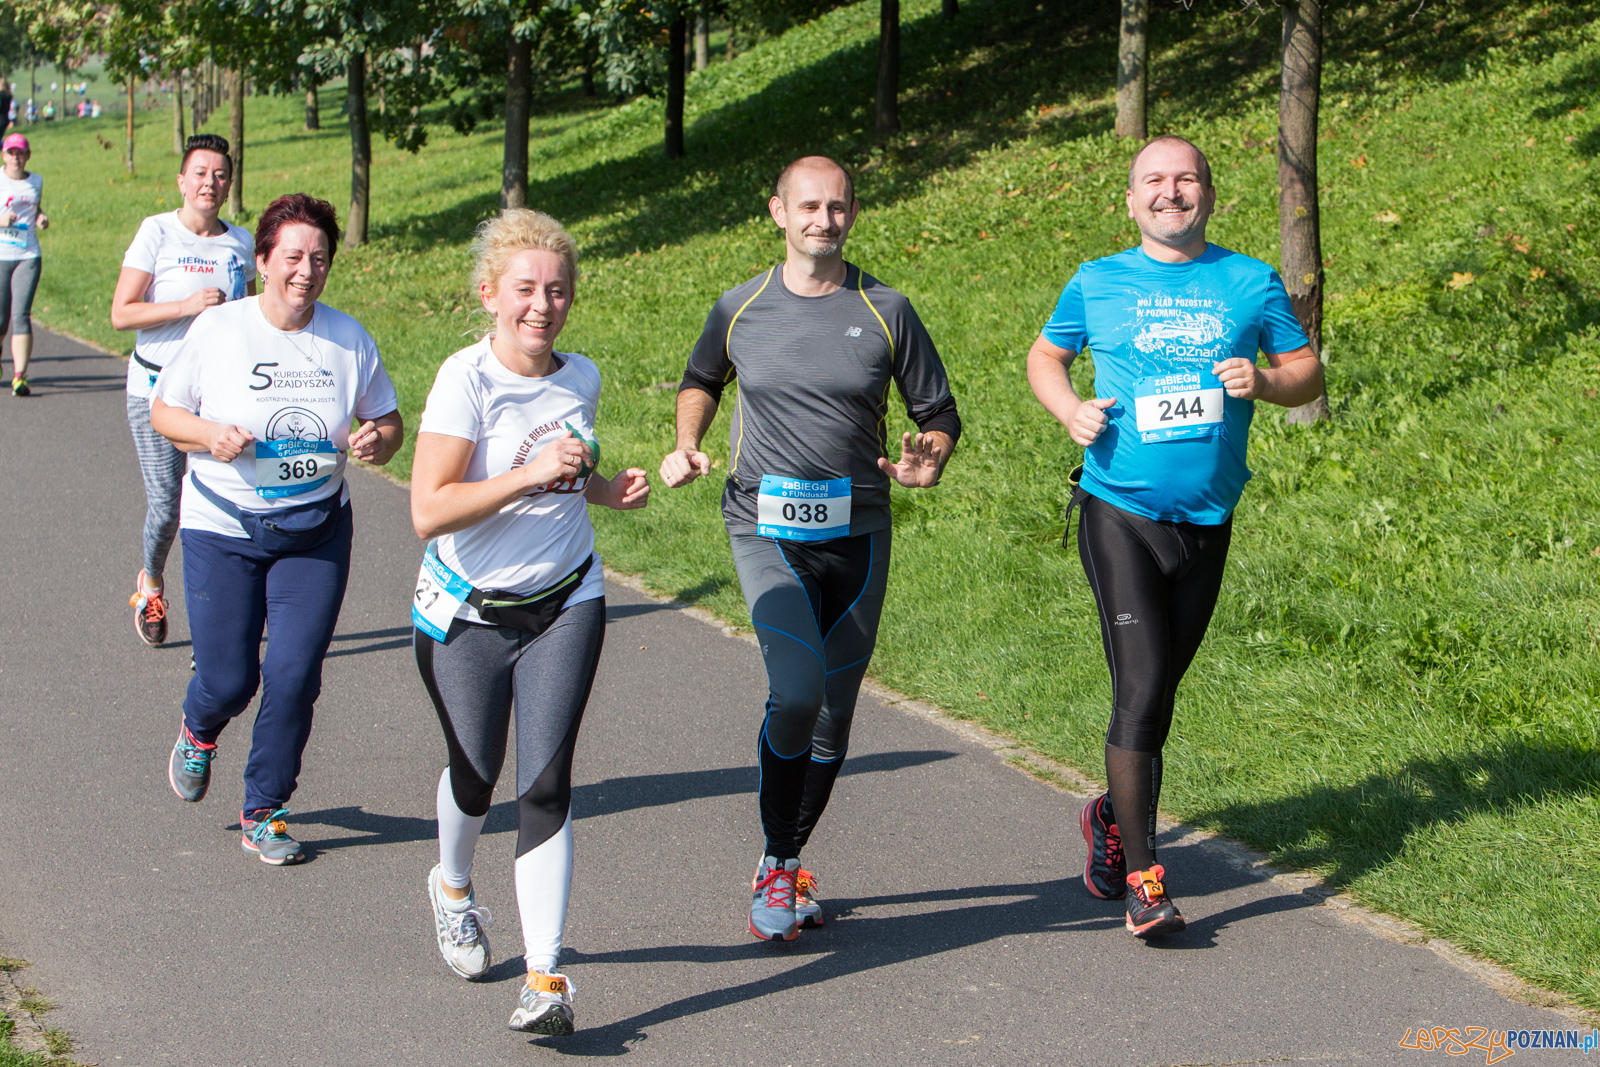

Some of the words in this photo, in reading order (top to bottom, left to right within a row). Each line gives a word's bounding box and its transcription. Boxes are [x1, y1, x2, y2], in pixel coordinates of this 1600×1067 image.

[177, 256, 219, 267] HERNIK
[182, 264, 215, 274] TEAM
[1146, 308, 1182, 318] POZNANIU
[248, 362, 280, 391] 5
[273, 370, 334, 379] KURDESZOWA
[1154, 372, 1201, 386] zaBIEGaj
[273, 379, 336, 390] (ZA)DYSZKA
[1163, 384, 1202, 393] FUNdusze
[1158, 396, 1204, 422] 244
[528, 420, 564, 442] BIEGAJĄ
[277, 440, 318, 452] zaBIEGaj
[278, 458, 318, 481] 369
[782, 481, 829, 492] zaBIEGaj
[782, 502, 828, 524] 038
[415, 578, 440, 610] 21
[550, 980, 566, 991] 02
